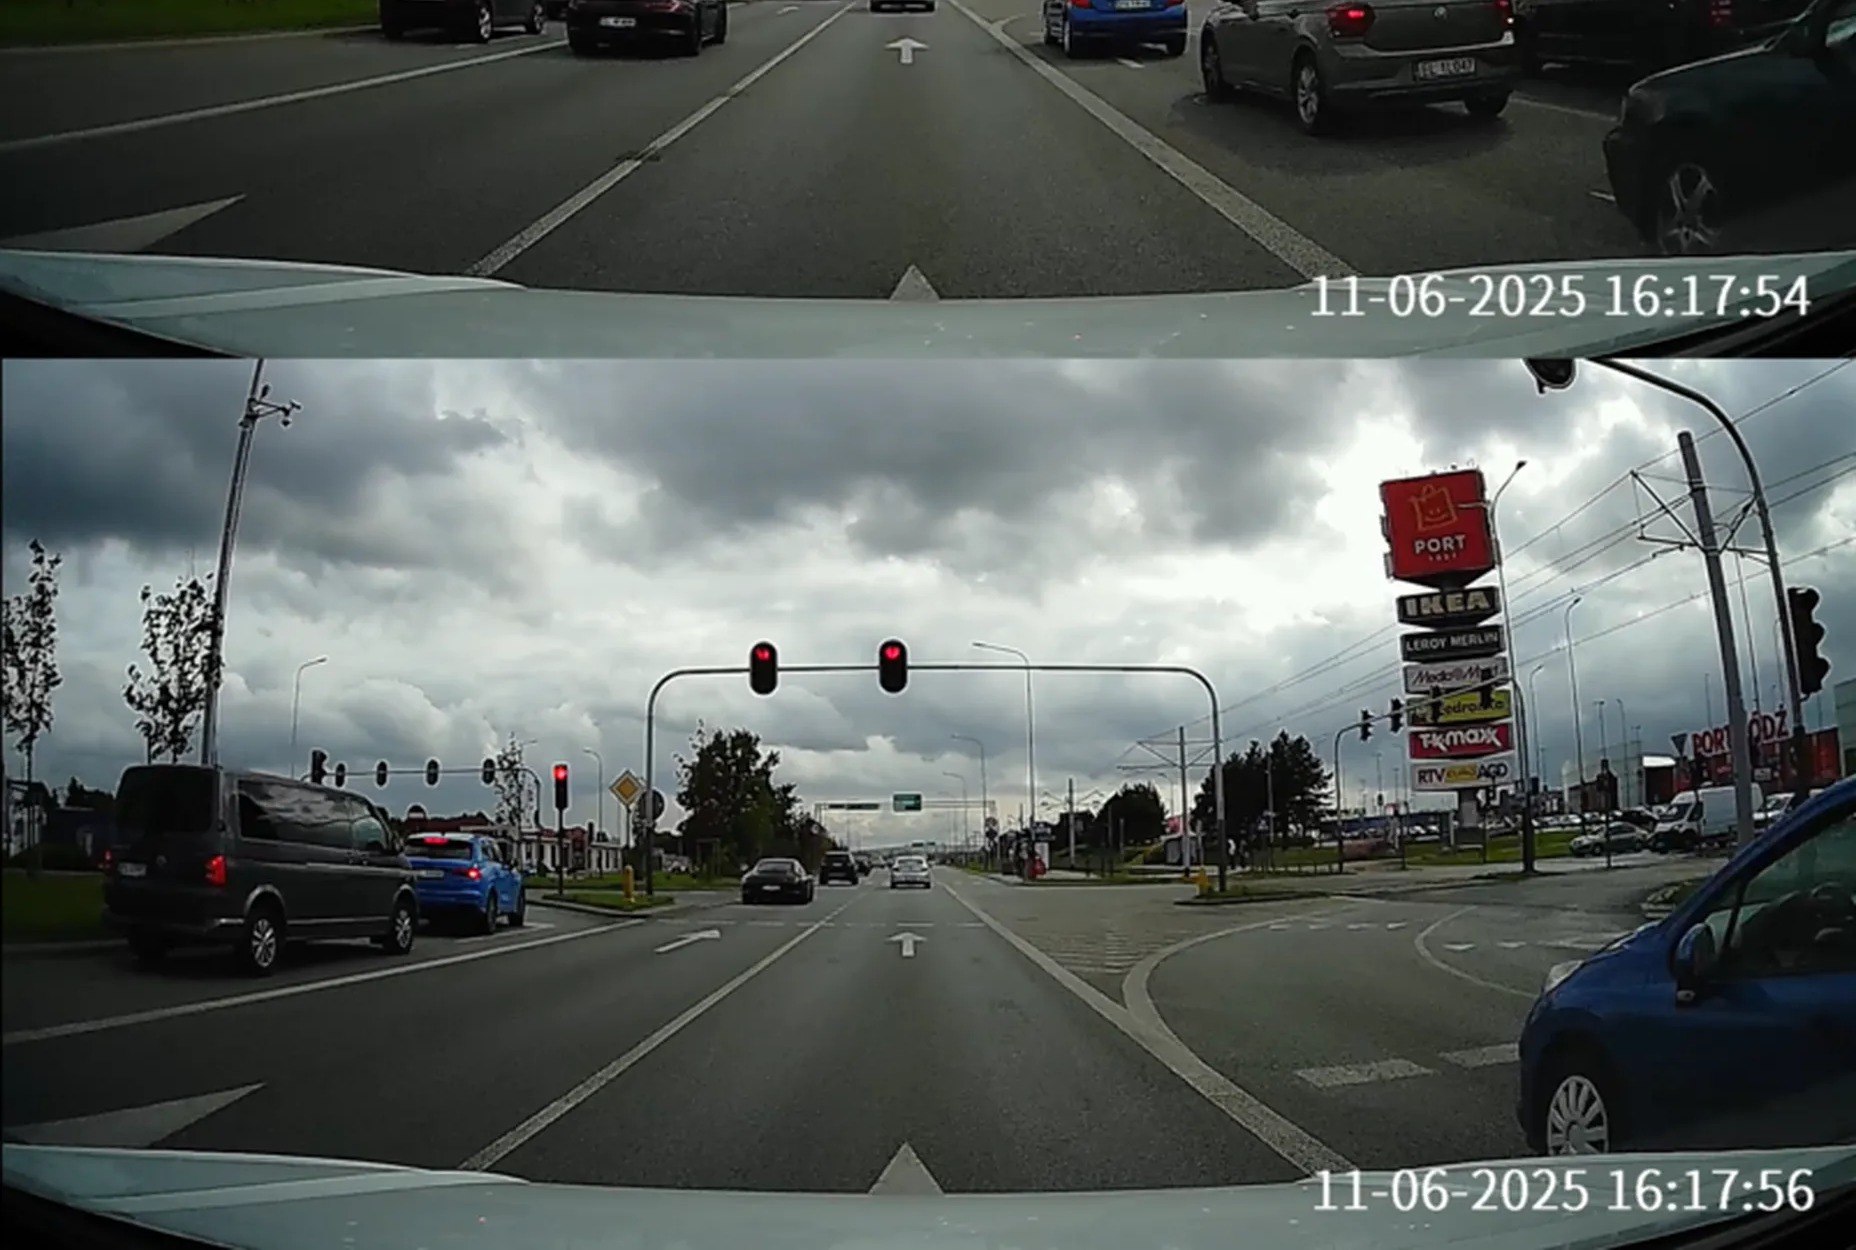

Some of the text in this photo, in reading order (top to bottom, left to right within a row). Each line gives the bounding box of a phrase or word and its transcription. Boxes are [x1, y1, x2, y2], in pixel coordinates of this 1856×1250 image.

[1414, 534, 1466, 554] PORT
[1405, 591, 1490, 616] IKEA
[1406, 631, 1499, 651] LEROY MERLIN
[1418, 768, 1445, 784] RTV
[1477, 761, 1509, 779] AGD
